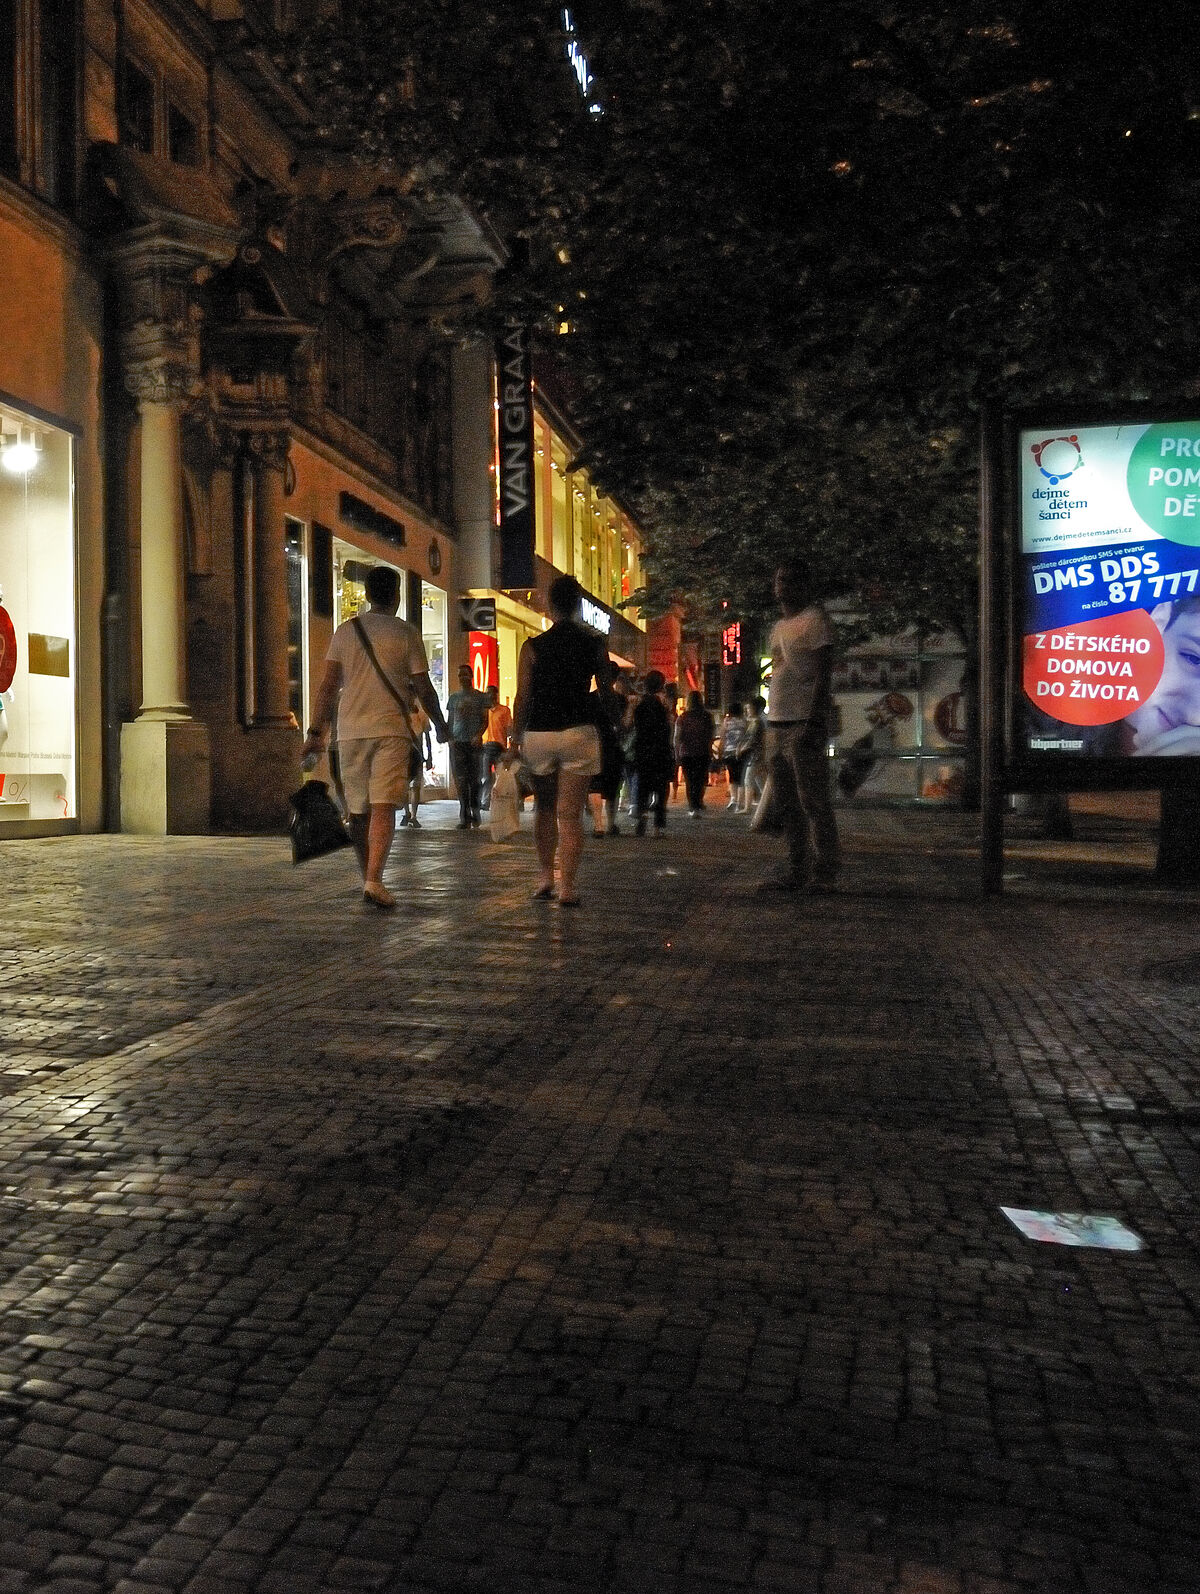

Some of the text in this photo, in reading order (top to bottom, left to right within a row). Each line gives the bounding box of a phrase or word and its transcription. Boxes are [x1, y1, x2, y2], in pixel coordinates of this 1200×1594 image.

[504, 441, 527, 518] VAN
[1031, 487, 1070, 500] dejme
[1039, 509, 1071, 520] šanci
[1049, 499, 1088, 510] dětem
[1164, 494, 1200, 517] DĚ
[1031, 527, 1133, 544] www.dejmedetemsanci.cz
[1058, 554, 1097, 566] dárcovskou
[1098, 550, 1113, 559] SMS
[1033, 551, 1160, 594] DMS DDS
[1108, 579, 1141, 604] 87
[1147, 569, 1199, 598] 777
[1034, 632, 1150, 654] Z DĚTSKÉHO
[1047, 658, 1133, 677] DOMOVA
[1036, 680, 1139, 701] DO ŽIVOTA
